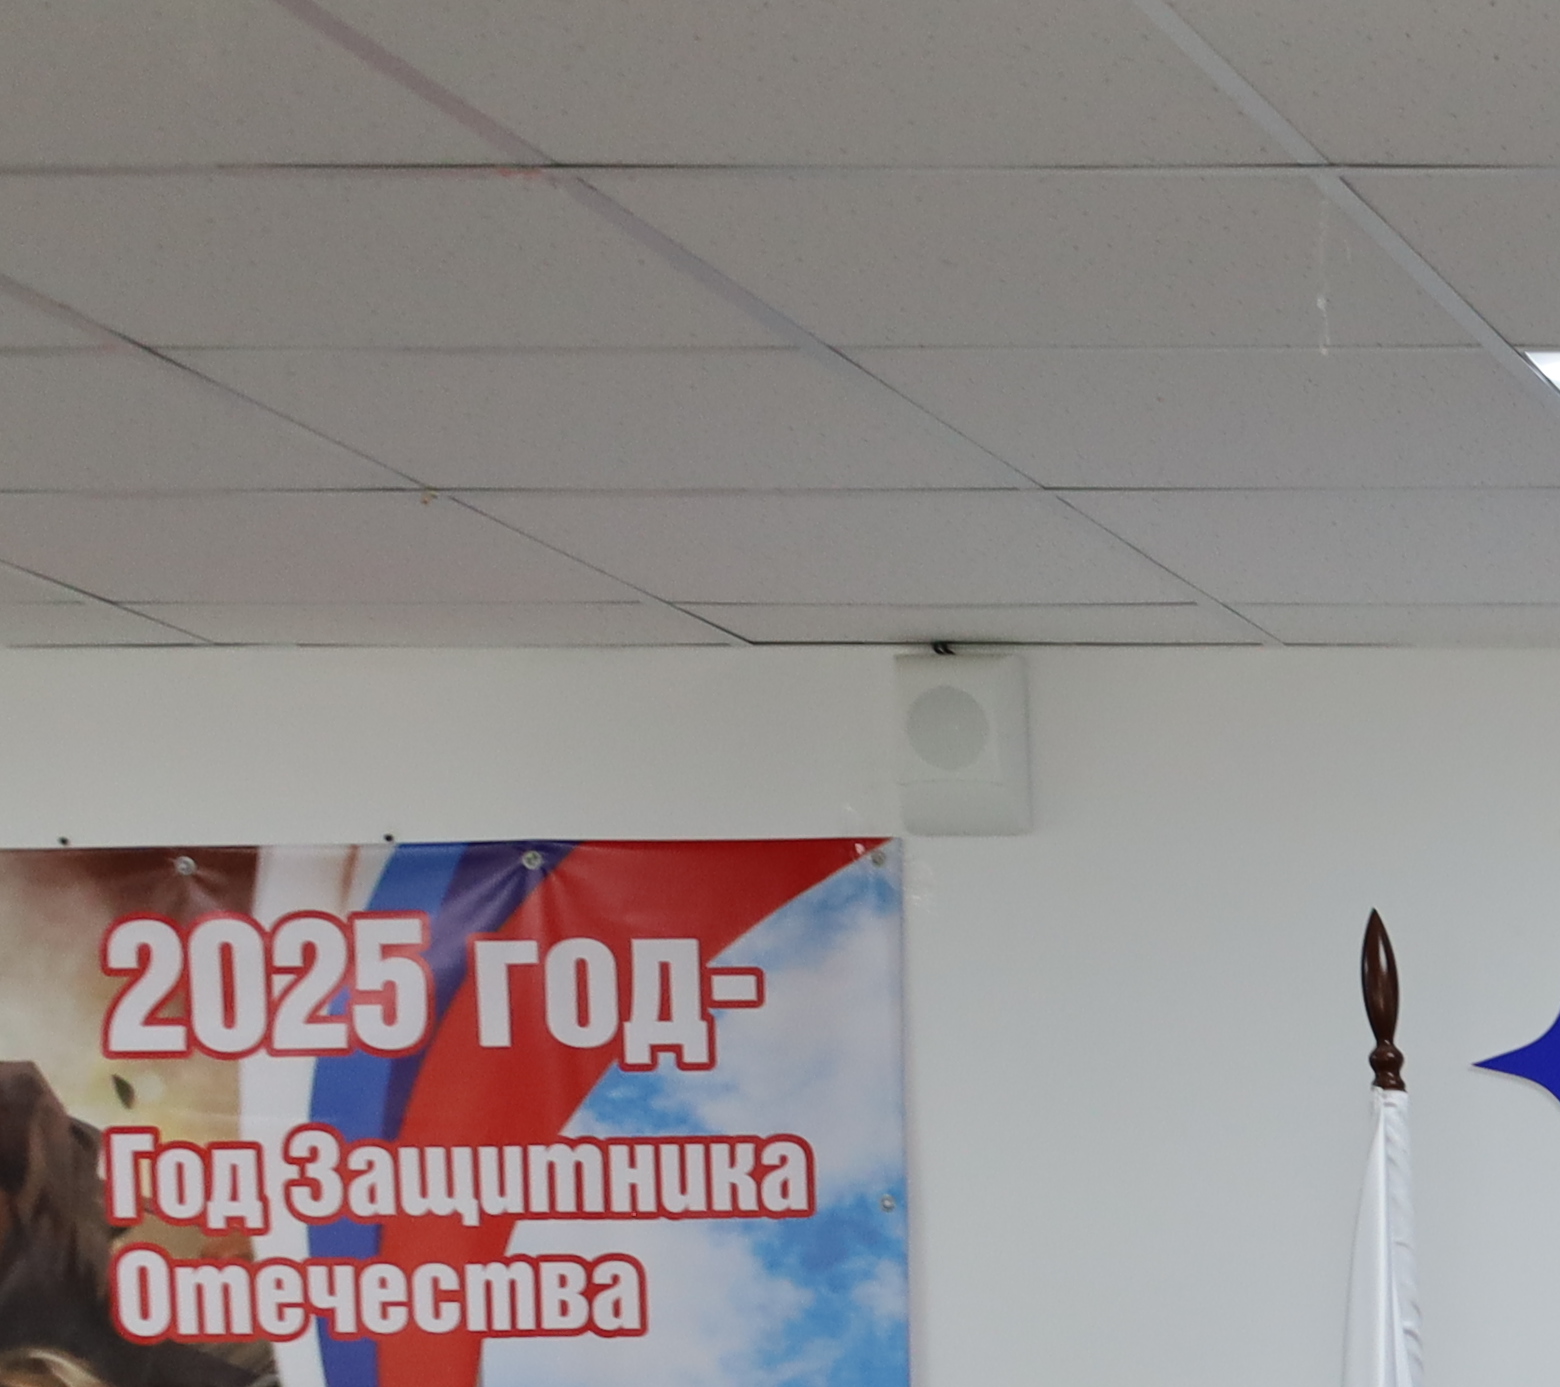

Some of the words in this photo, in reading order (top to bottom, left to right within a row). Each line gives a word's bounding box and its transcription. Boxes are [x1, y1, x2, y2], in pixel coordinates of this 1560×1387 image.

[103, 911, 432, 1058] 2025
[106, 1130, 268, 1234] Год
[284, 1126, 813, 1224] Защитника
[113, 1251, 647, 1340] Отечества
